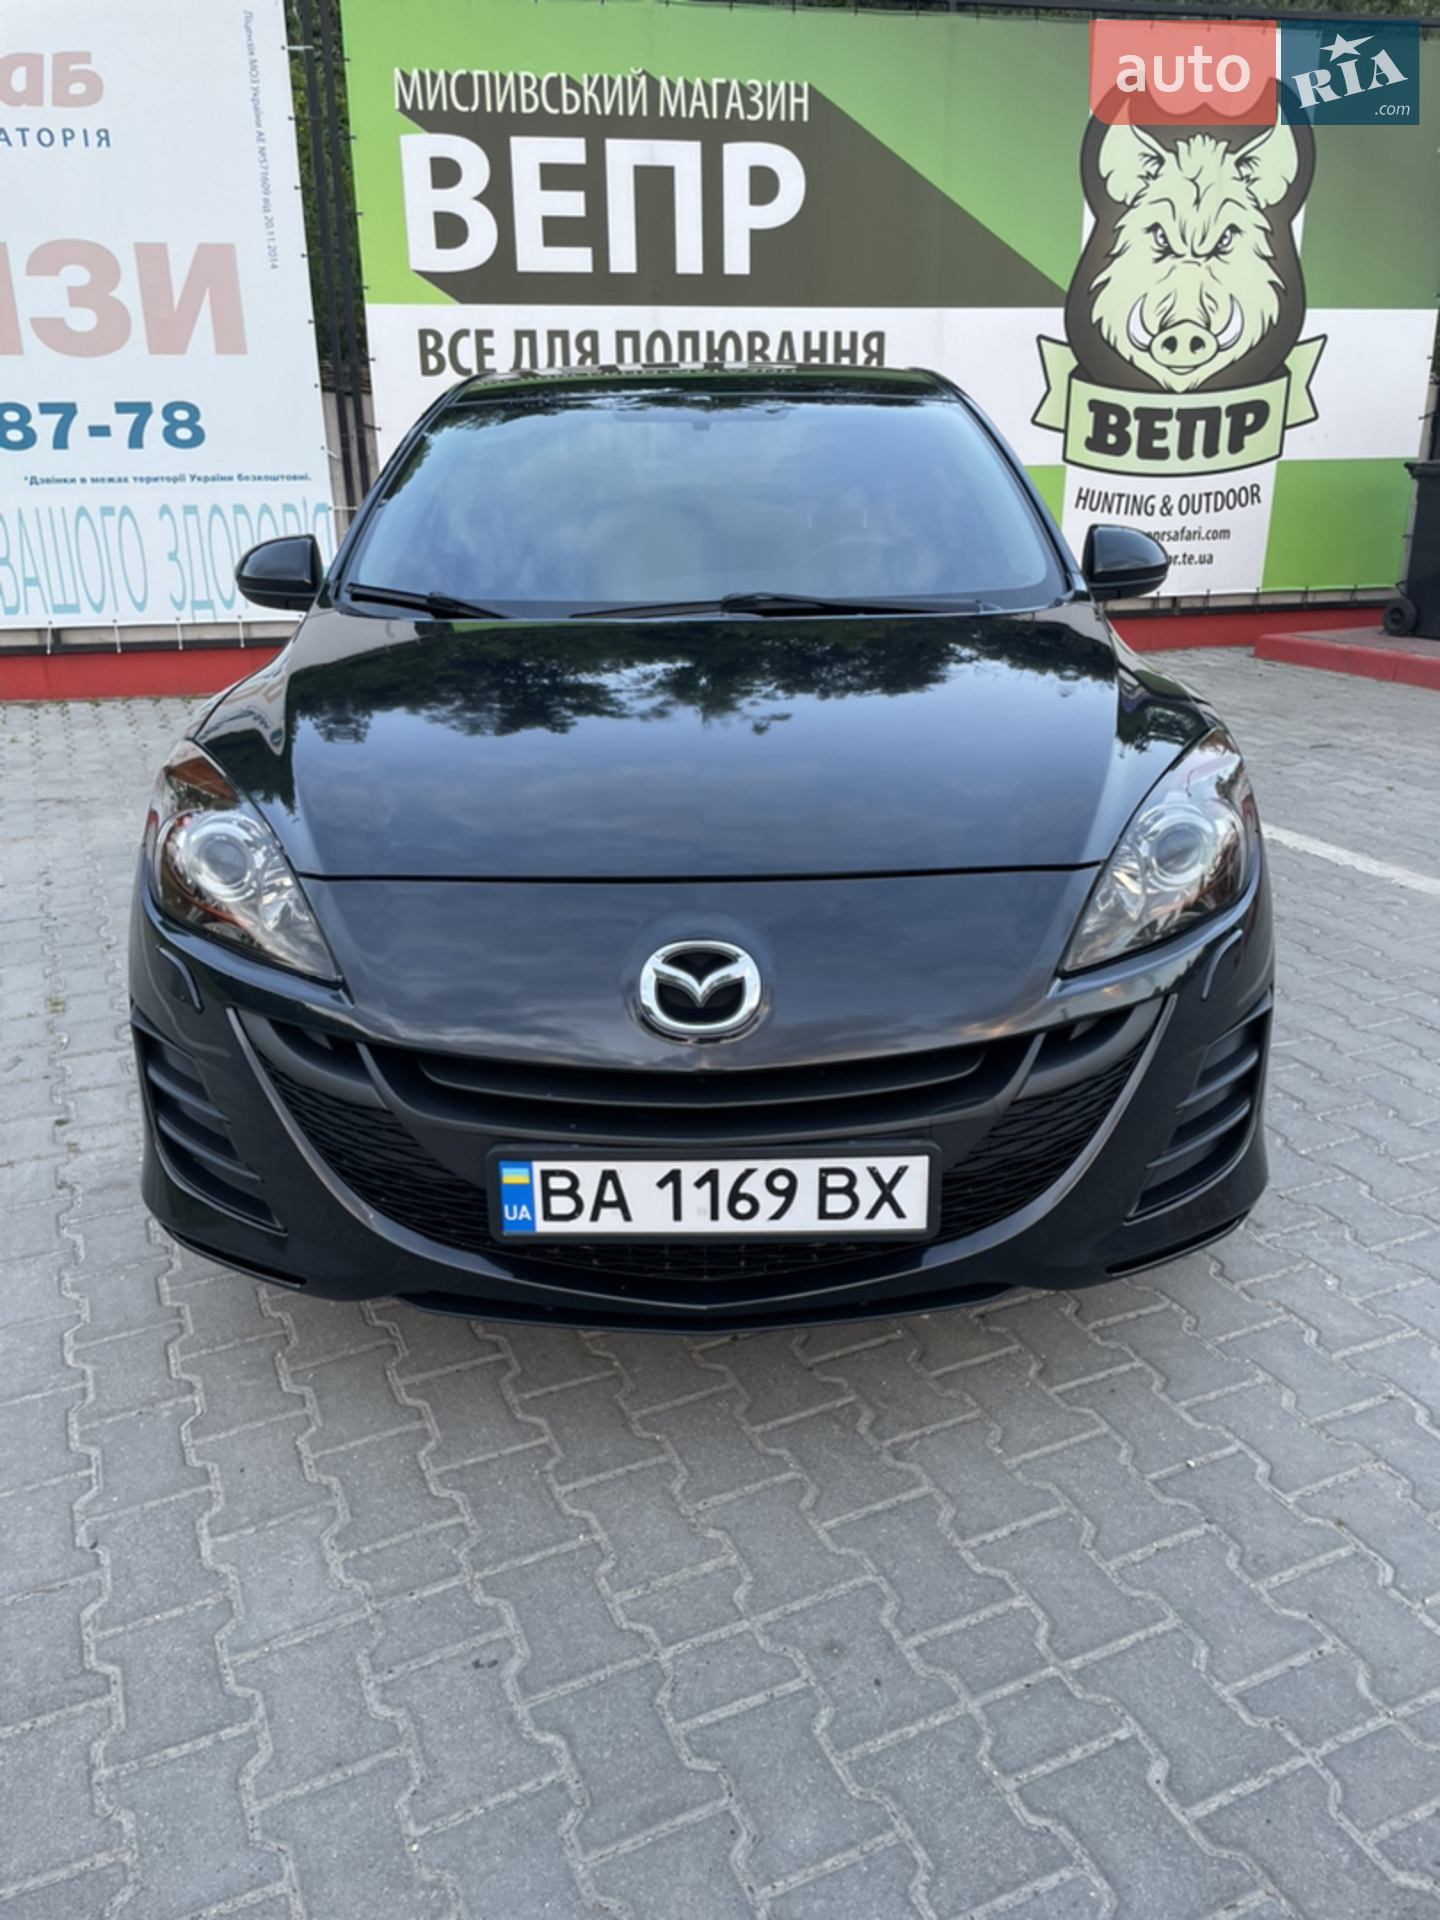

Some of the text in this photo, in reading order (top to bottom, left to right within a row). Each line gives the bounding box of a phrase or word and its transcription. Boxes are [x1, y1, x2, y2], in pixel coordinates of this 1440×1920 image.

[249, 59, 260, 84] МОЗ
[393, 67, 810, 121] МИСЛИВСЬКИЙ МАГАЗИН
[250, 86, 264, 128] України
[399, 133, 806, 274] ВЕПР
[264, 215, 279, 270] 20.11.2014
[418, 328, 496, 376] ВСЕ
[1084, 398, 1270, 461] ВЕПР
[189, 473, 234, 484] України
[1075, 483, 1262, 517] HUNTING & OUTDOOR
[504, 1204, 531, 1221] UA
[540, 1165, 909, 1222] BA 1169 BX
